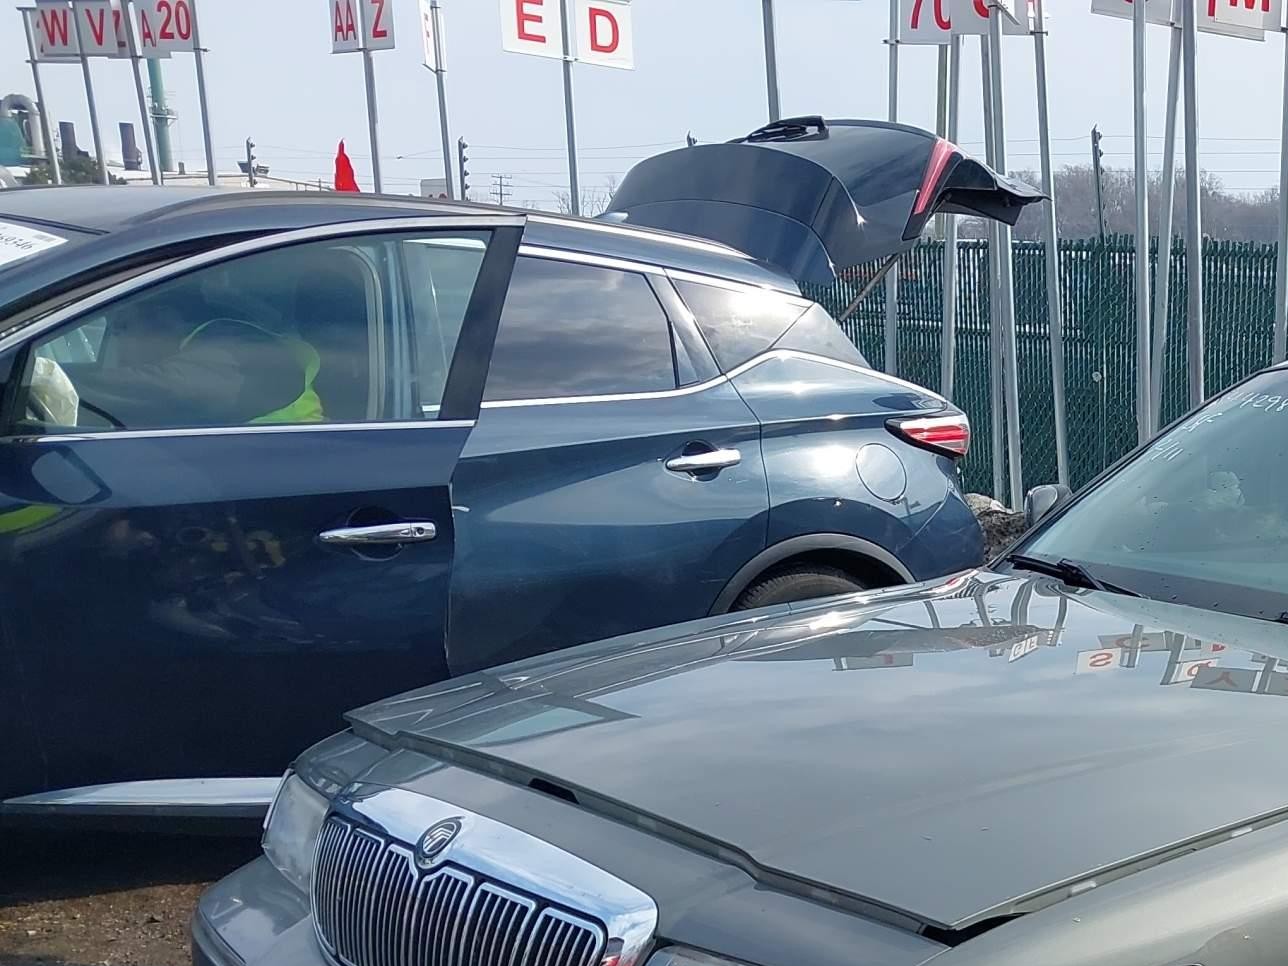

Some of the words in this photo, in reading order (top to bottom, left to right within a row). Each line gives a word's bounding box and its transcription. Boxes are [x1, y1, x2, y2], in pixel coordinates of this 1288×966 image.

[41, 9, 68, 46] W
[85, 8, 104, 46] V
[156, 0, 191, 40] 20
[334, 0, 357, 42] AA
[371, 0, 387, 38] Z
[515, 0, 546, 43] E
[589, 7, 619, 53] D
